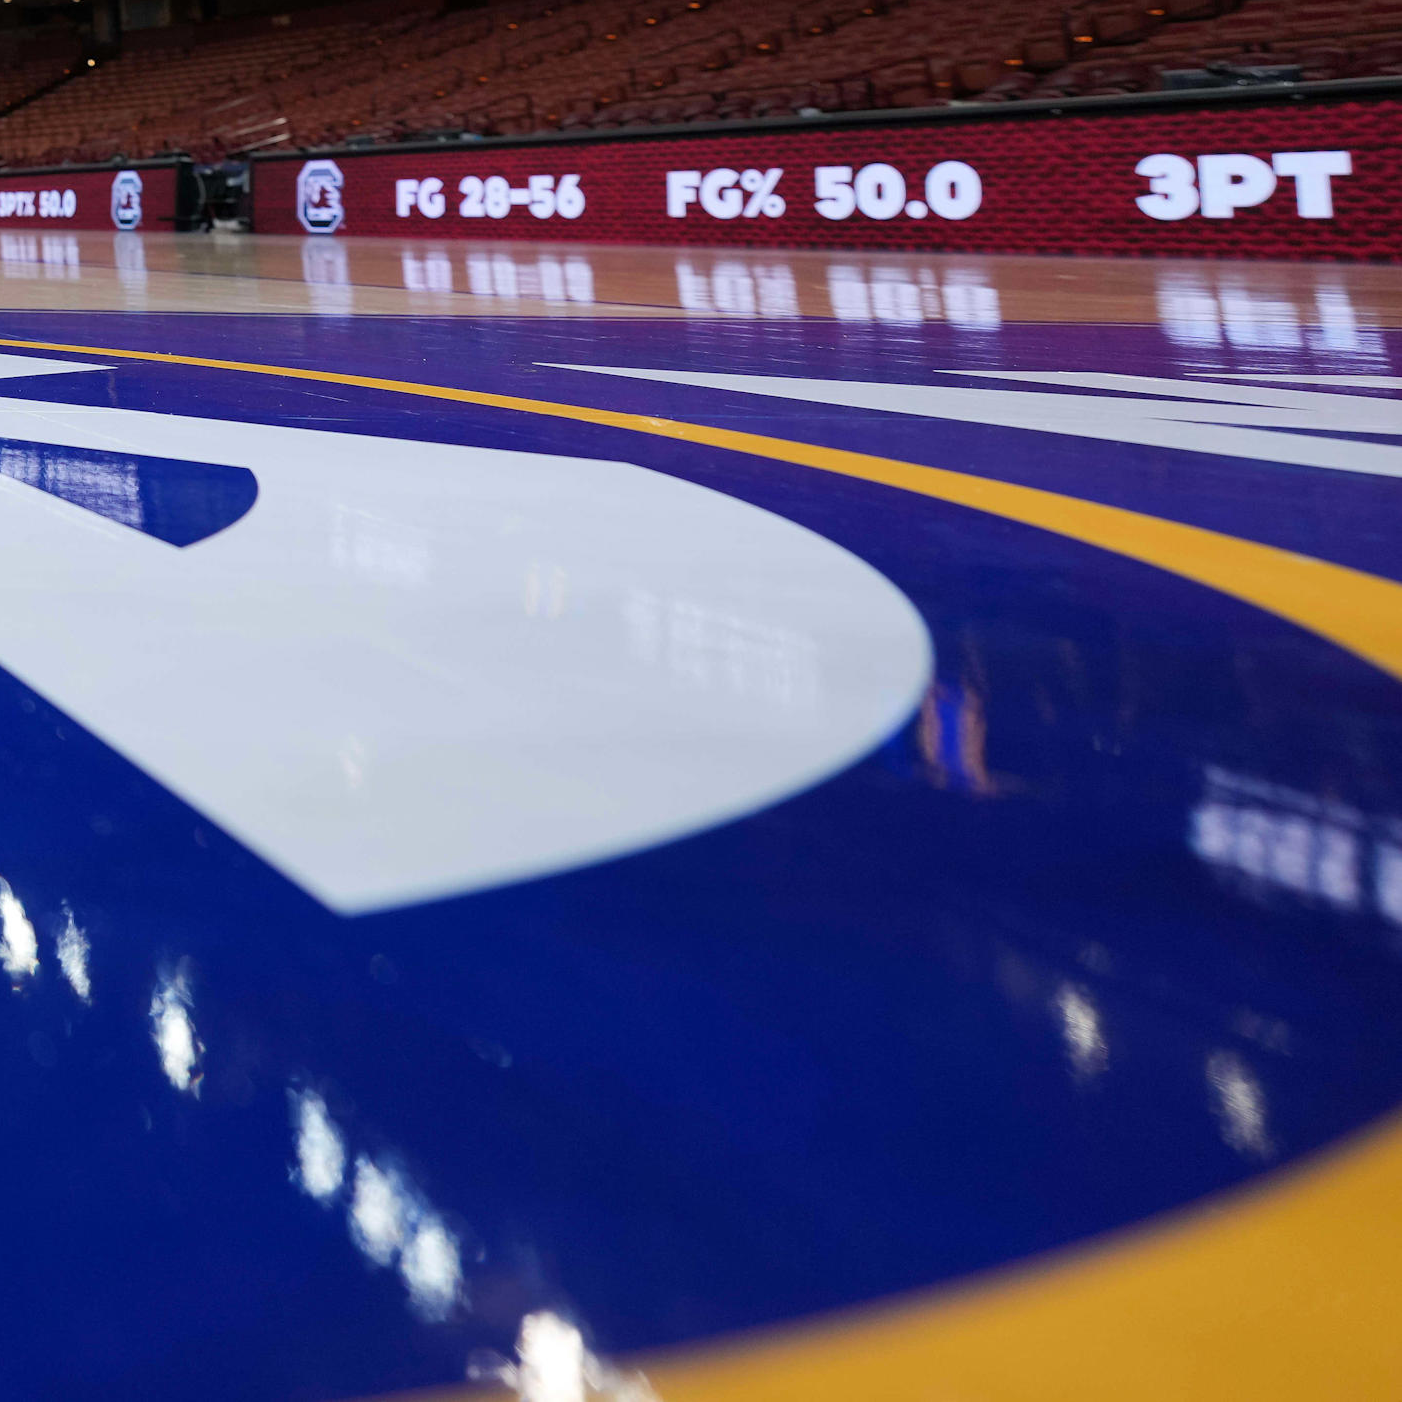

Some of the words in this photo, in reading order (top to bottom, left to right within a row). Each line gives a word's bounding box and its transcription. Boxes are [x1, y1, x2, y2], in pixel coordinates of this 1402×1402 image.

[38, 188, 77, 219] 50.0
[395, 176, 446, 220] FG
[458, 173, 586, 220] 28-56
[665, 167, 787, 221] FG%
[813, 159, 983, 221] 50.0
[1133, 149, 1353, 222] 3PT
